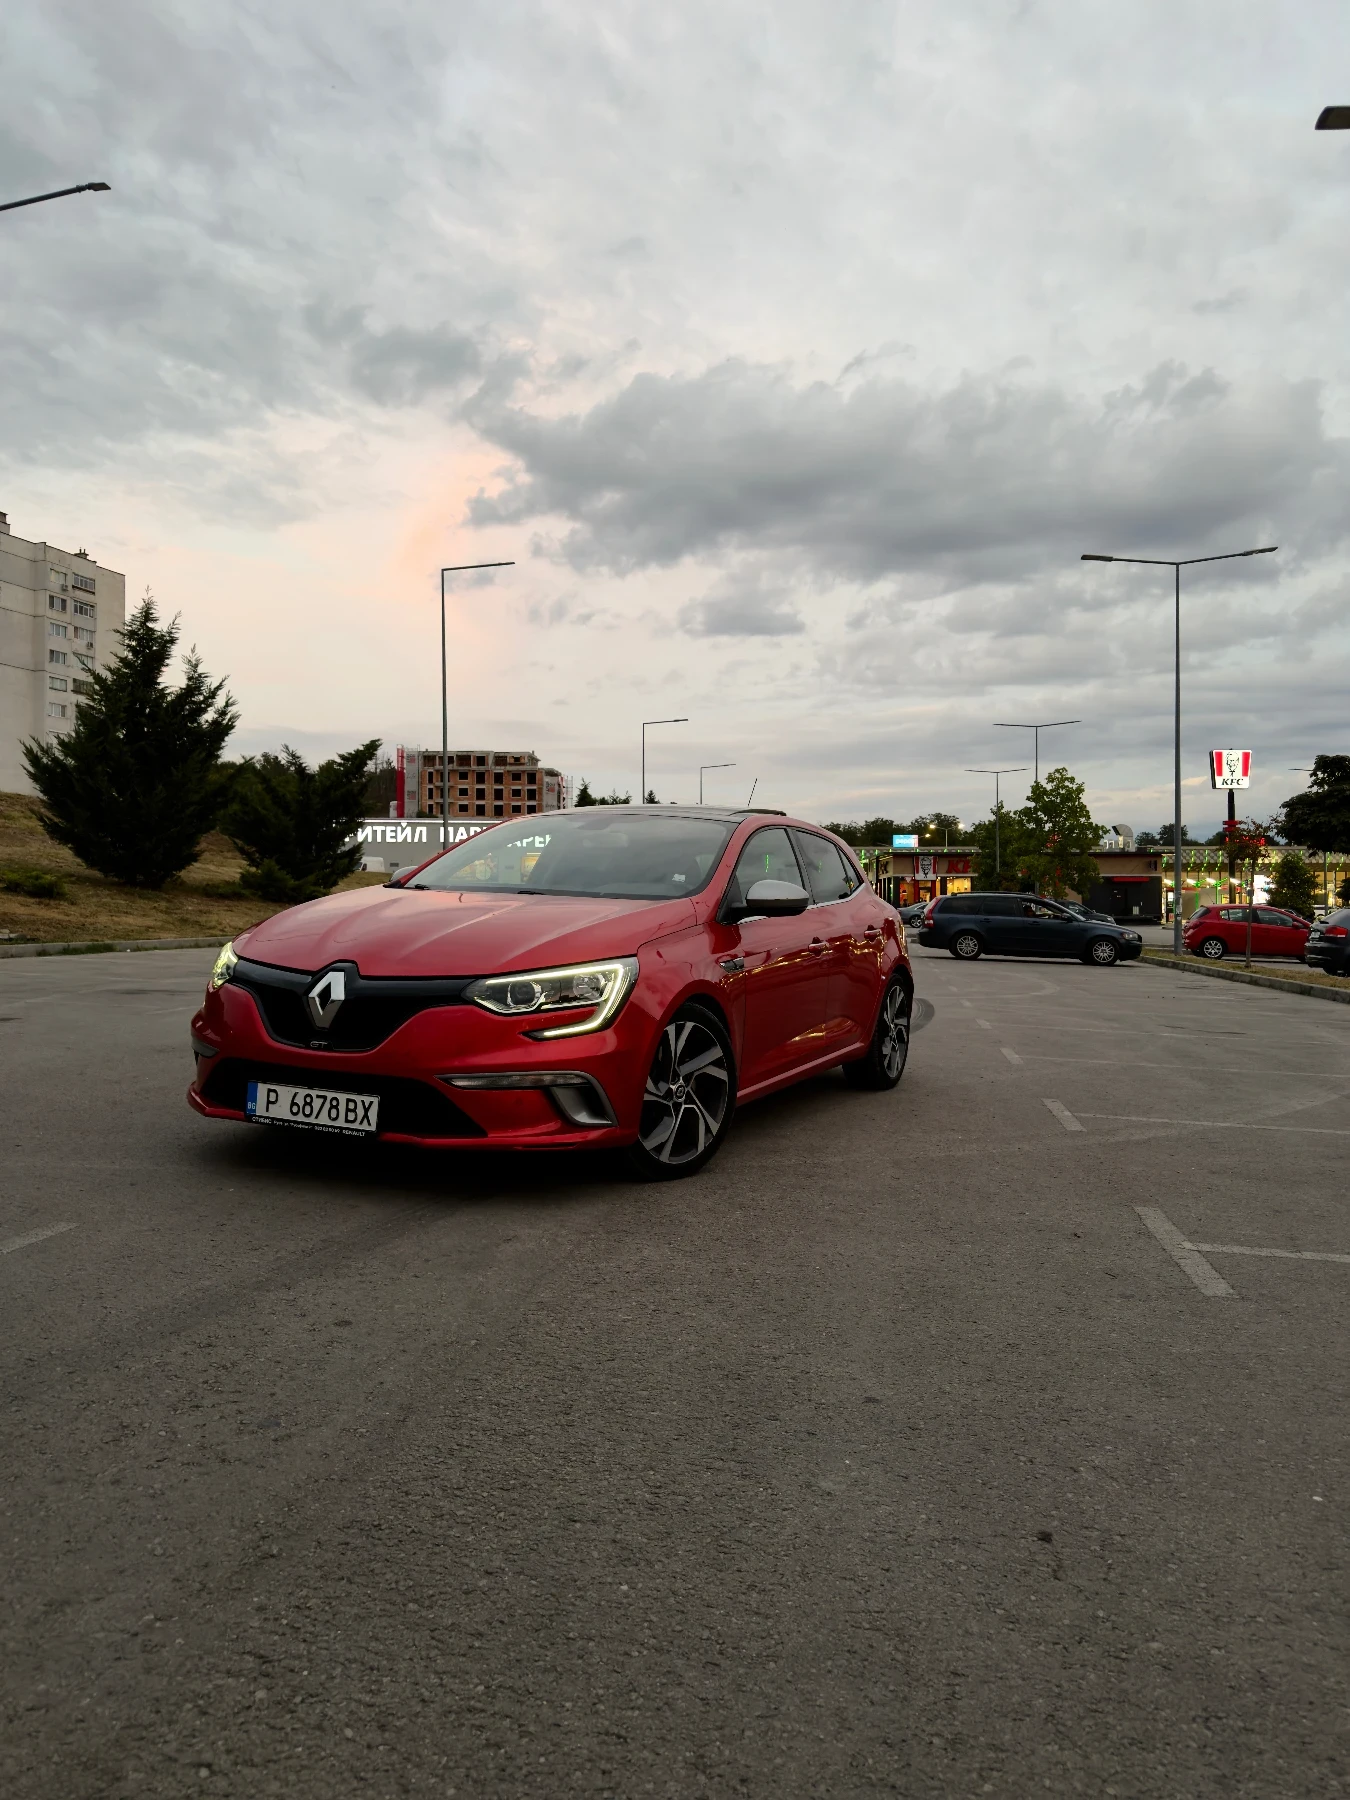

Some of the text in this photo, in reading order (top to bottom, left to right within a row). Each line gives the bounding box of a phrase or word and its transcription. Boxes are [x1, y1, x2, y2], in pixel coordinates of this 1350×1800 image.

[1221, 778, 1244, 786] KFC
[344, 822, 427, 843] ИТЕЙЛ
[439, 826, 487, 843] ПАР
[946, 859, 973, 874] KF
[309, 1041, 328, 1049] GT
[266, 1088, 279, 1112] P
[289, 1091, 340, 1122] 6878
